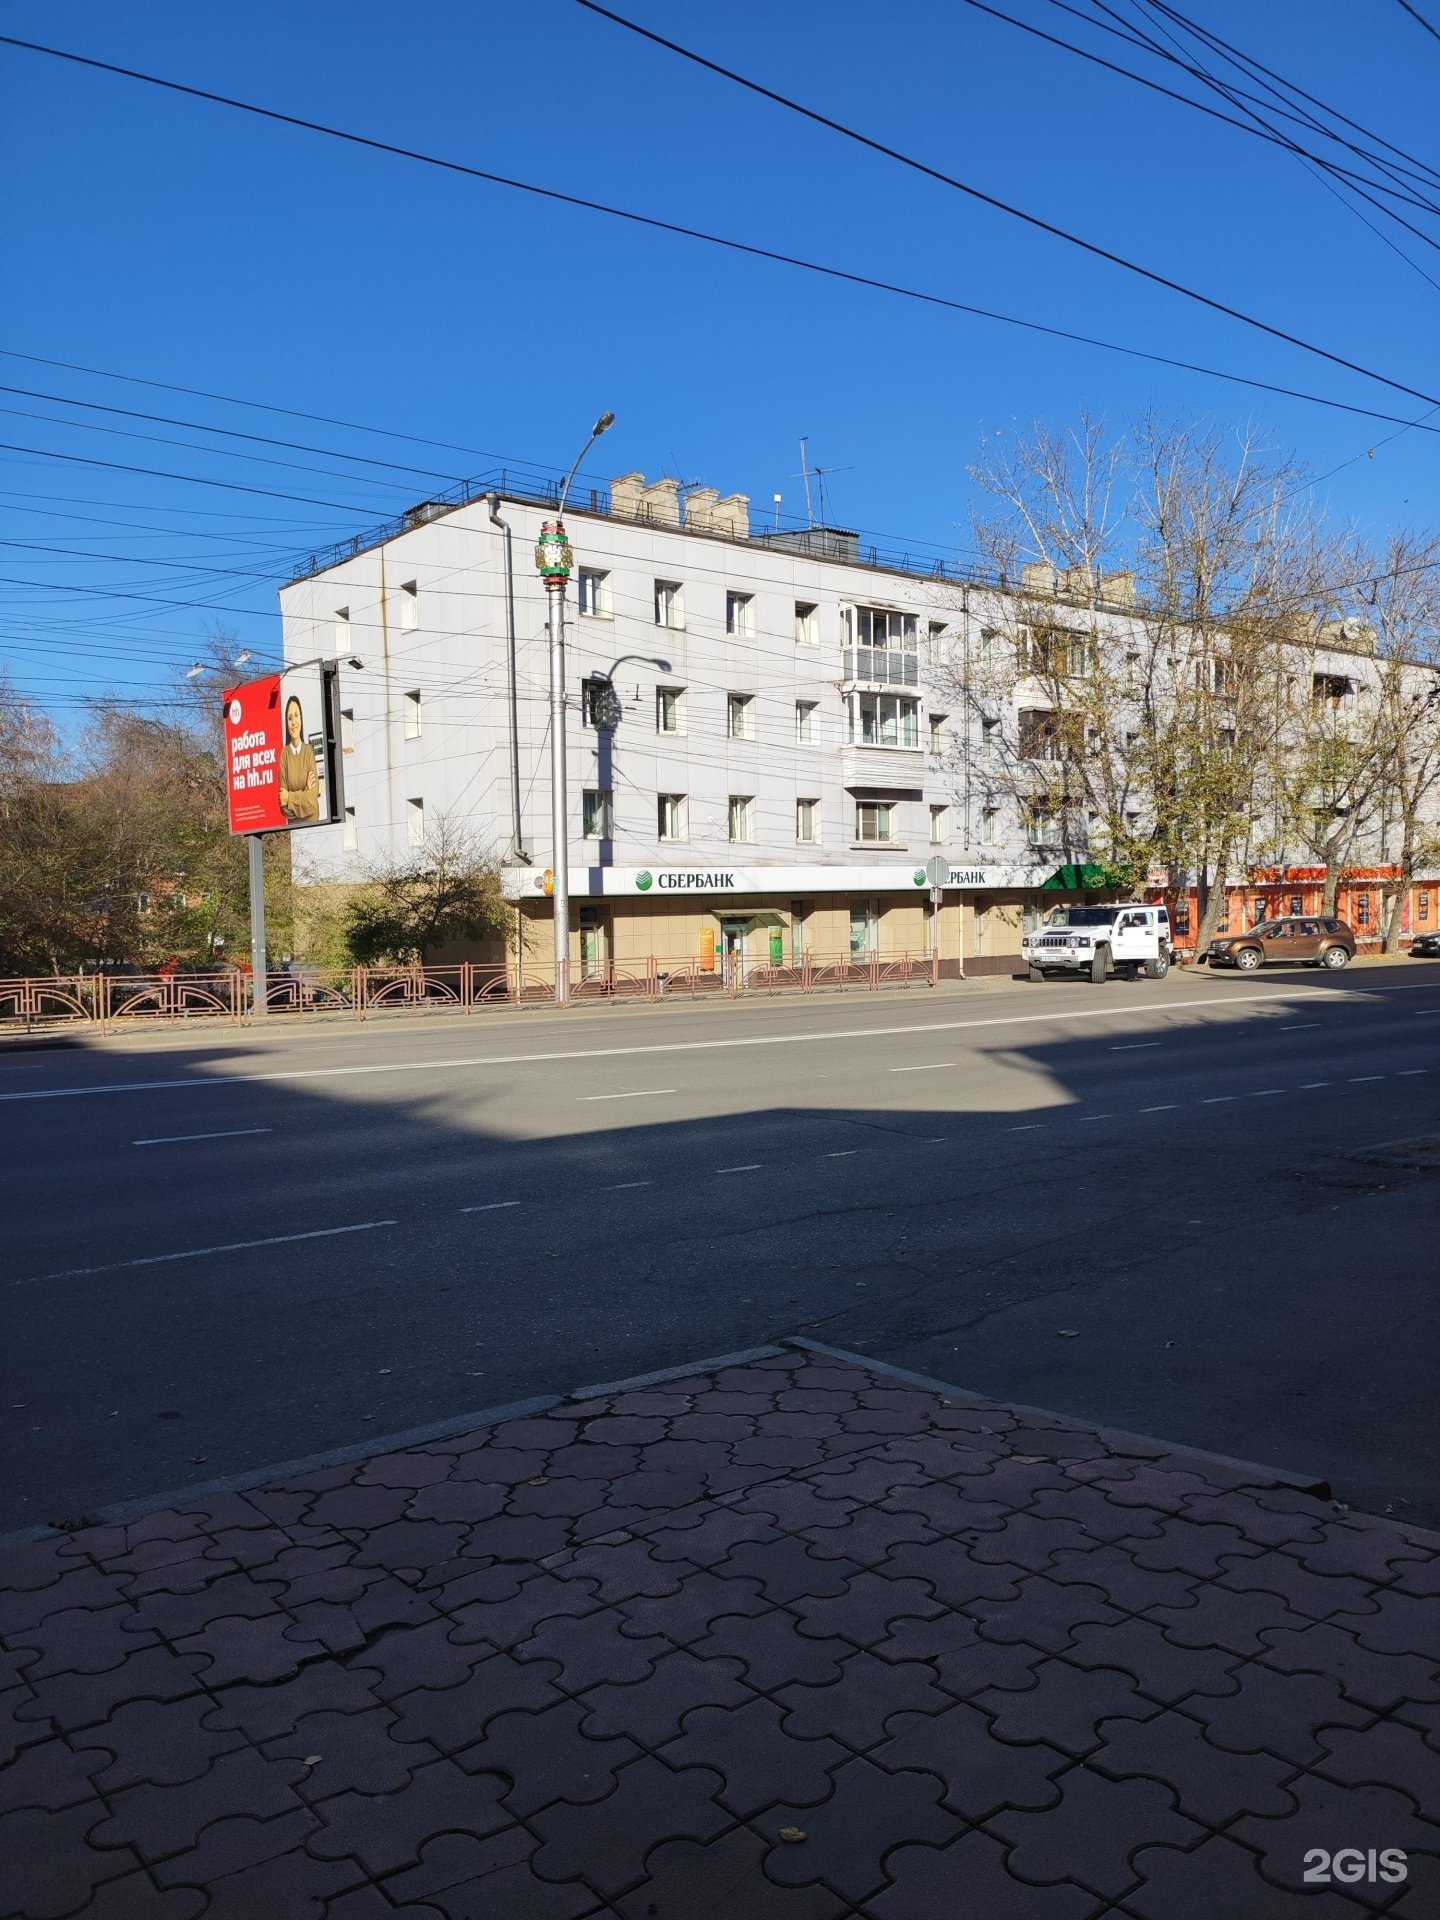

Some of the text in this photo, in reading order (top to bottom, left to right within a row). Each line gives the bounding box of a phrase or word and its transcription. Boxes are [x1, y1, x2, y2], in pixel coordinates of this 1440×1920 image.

[231, 730, 266, 756] работа
[232, 748, 276, 774] для всех
[233, 768, 273, 791] на hh.ru
[658, 873, 735, 889] СБЕРБАНК
[944, 871, 986, 884] РБАНК
